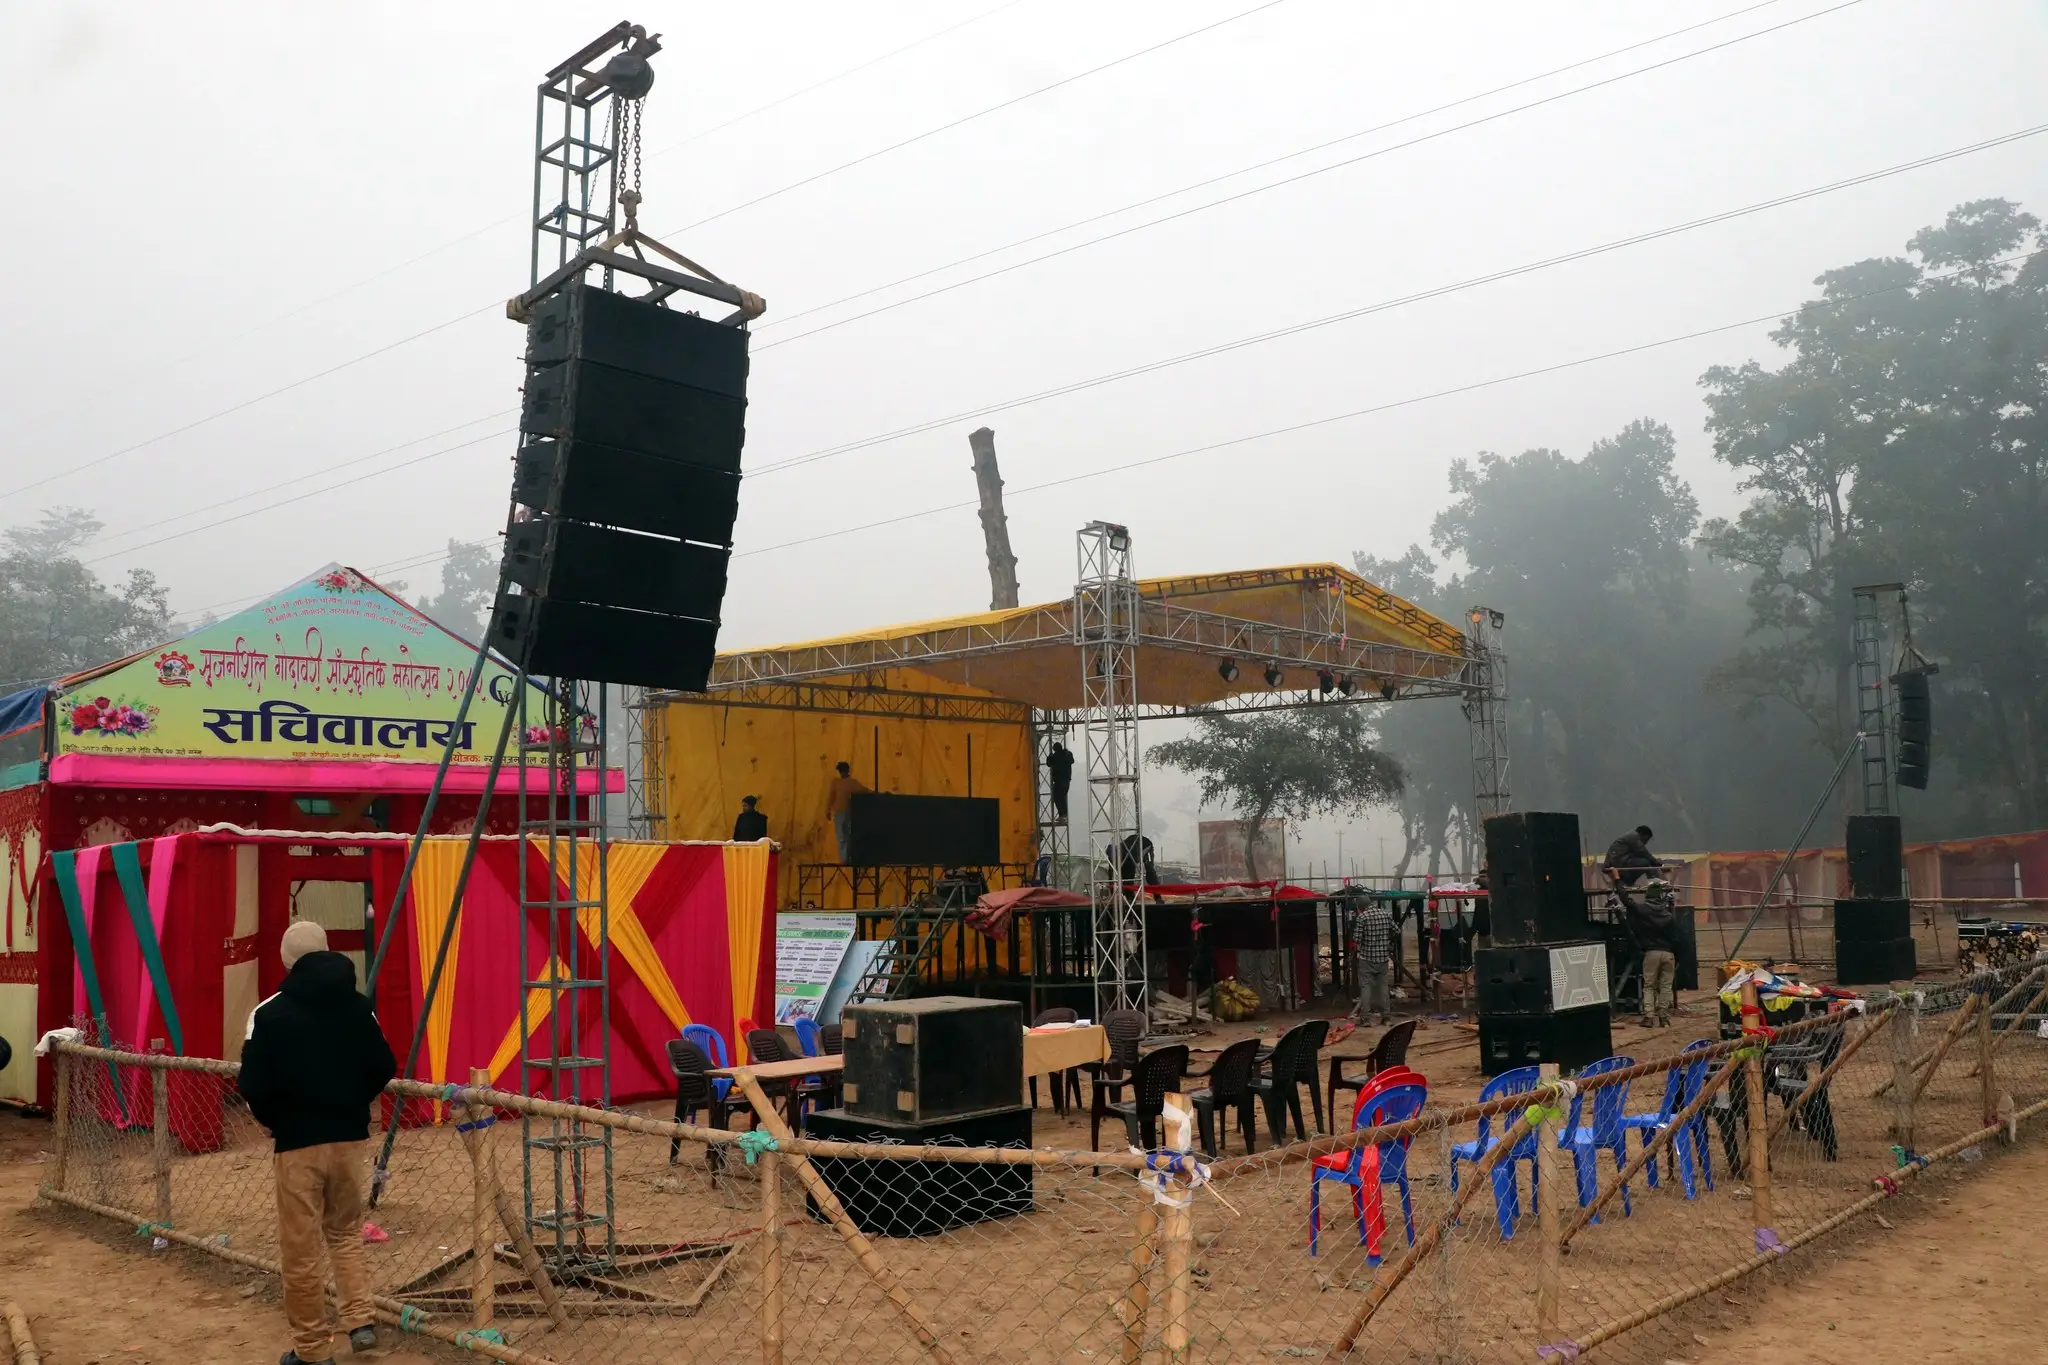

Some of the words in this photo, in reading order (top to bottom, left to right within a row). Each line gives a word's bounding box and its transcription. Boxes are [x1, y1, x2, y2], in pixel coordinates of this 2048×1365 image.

[274, 626, 323, 692] गोदावरी
[392, 643, 440, 700] महोत्सव
[202, 699, 477, 750] सचिवालय
